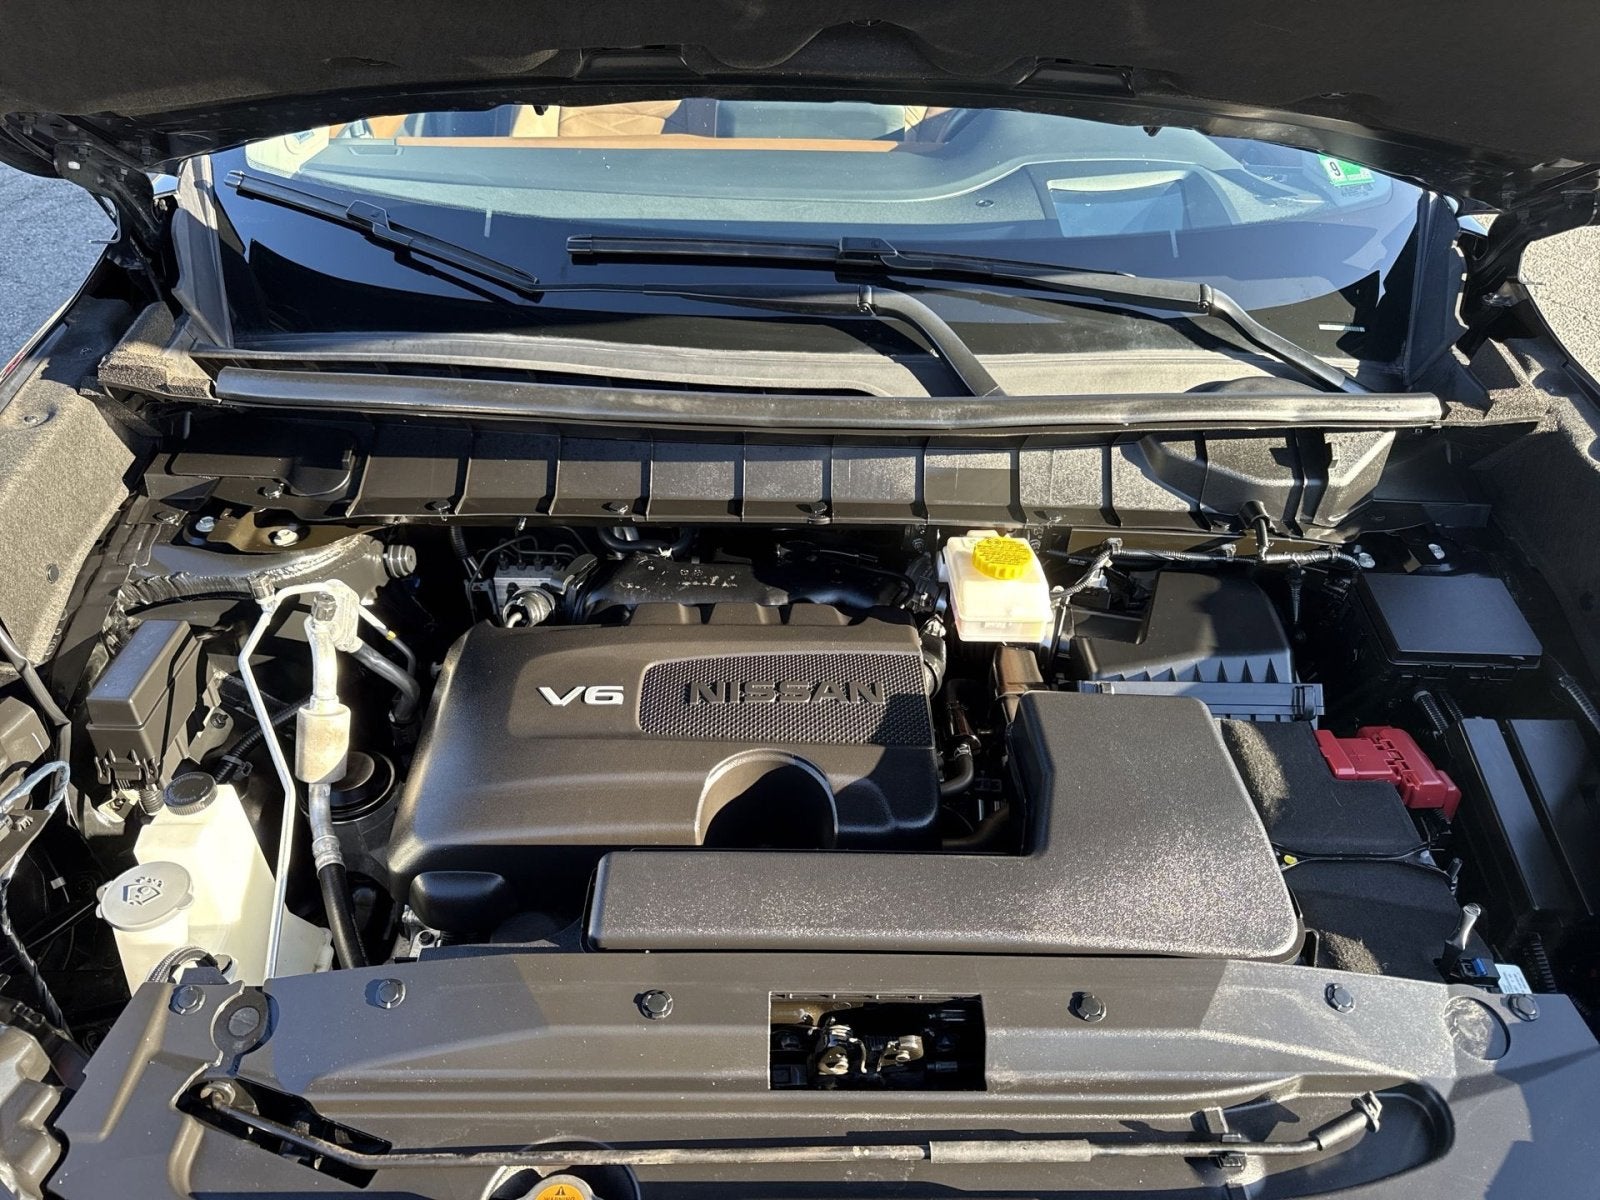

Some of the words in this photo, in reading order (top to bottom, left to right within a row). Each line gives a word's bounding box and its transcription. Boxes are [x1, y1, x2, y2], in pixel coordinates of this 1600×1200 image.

[1329, 161, 1341, 177] 9
[536, 685, 625, 707] V6
[689, 680, 884, 706] NISSAN
